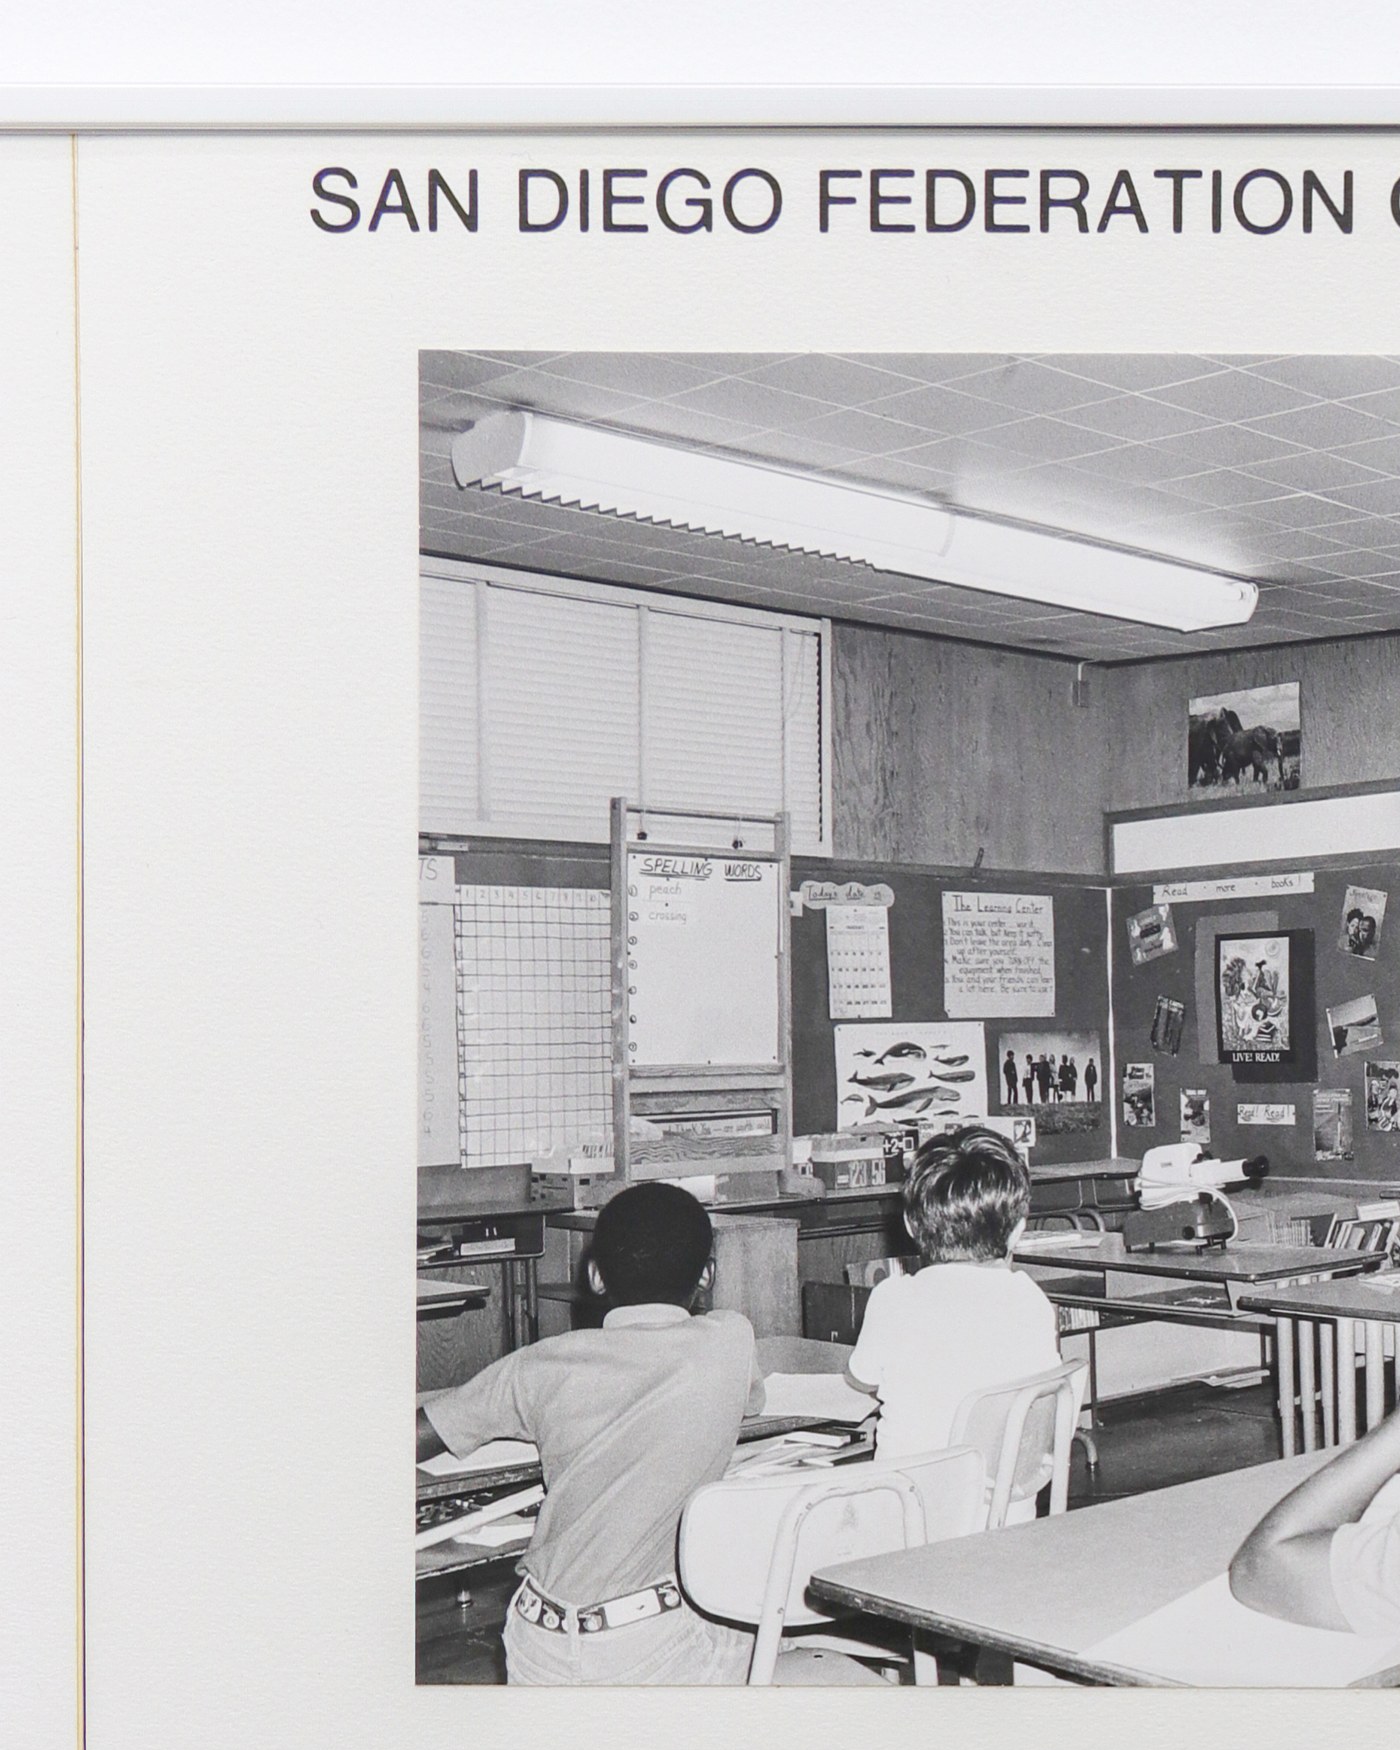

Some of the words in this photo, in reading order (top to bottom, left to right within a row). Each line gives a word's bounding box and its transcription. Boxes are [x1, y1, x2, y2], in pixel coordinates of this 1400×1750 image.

[310, 167, 478, 233] SAN
[518, 167, 783, 235] DIEGO
[819, 168, 1354, 235] FEDERATION
[644, 858, 712, 876] SPELLING
[725, 864, 761, 878] WORDS
[650, 883, 681, 898] peach
[806, 885, 837, 898] Today's
[846, 886, 863, 898] date
[1162, 885, 1187, 896] Read
[1216, 884, 1235, 892] more
[952, 895, 971, 910] The
[977, 895, 1011, 912] Learning
[1016, 898, 1043, 912] Center
[649, 912, 686, 924] crossing
[1233, 1053, 1252, 1062] LIVE!
[1255, 1053, 1280, 1061] READ!
